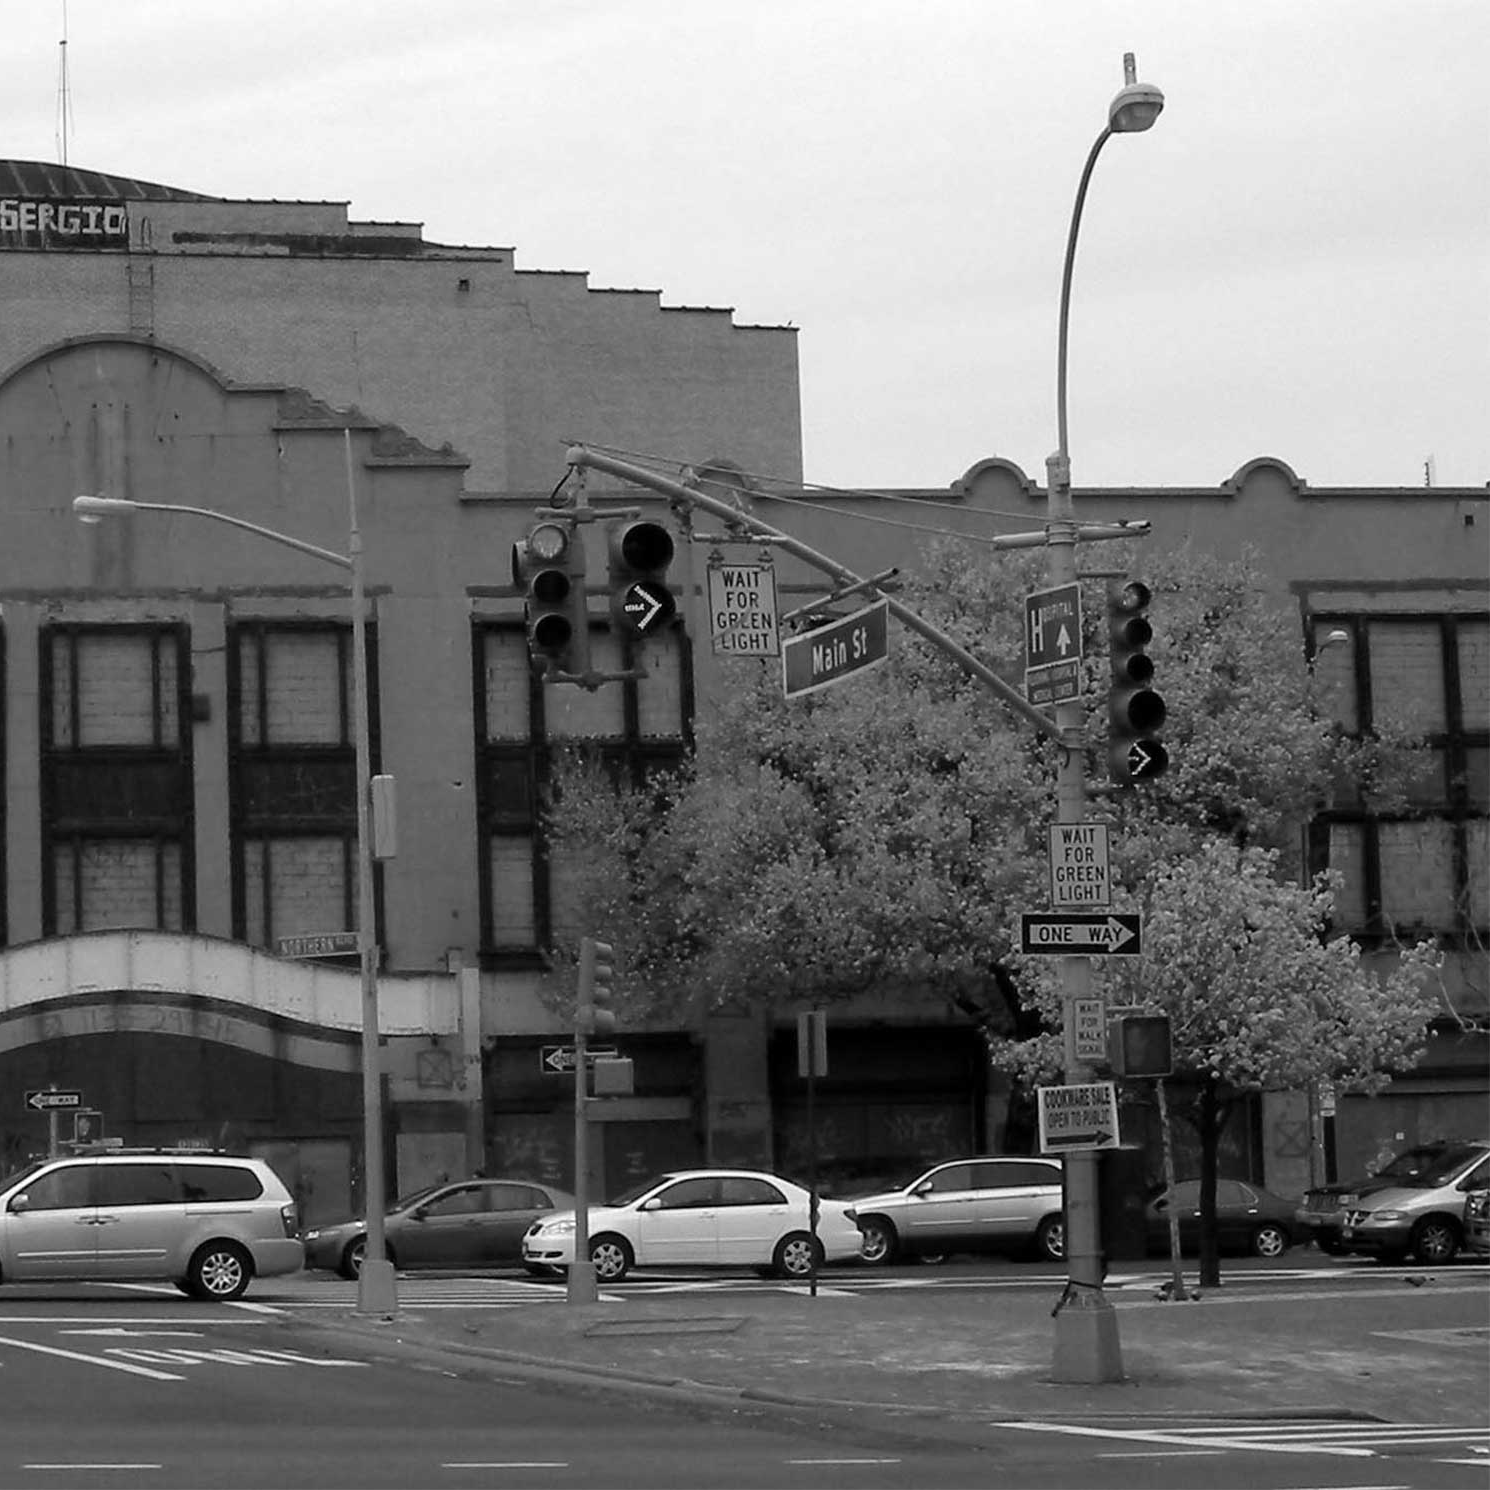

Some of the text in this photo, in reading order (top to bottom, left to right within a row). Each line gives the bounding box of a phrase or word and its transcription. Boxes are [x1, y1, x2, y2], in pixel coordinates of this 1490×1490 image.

[0, 200, 126, 234] SERGIO
[722, 571, 760, 588] WAIT
[726, 592, 760, 608] FOR
[722, 633, 769, 650] LIGHT
[813, 626, 867, 675] Main St
[1062, 828, 1095, 843] WAIT
[1065, 847, 1094, 862] FOR
[1056, 866, 1104, 882] GREEN
[1059, 885, 1102, 901] LIGHT
[1039, 926, 1123, 942] ONE WAY
[281, 937, 335, 955] NORTHERN
[1081, 1017, 1098, 1028] FOR
[1078, 1031, 1101, 1041] WALK
[1044, 1087, 1111, 1109] COOKWARE SALE
[1048, 1108, 1110, 1129] OPEN TO PUBLIC
